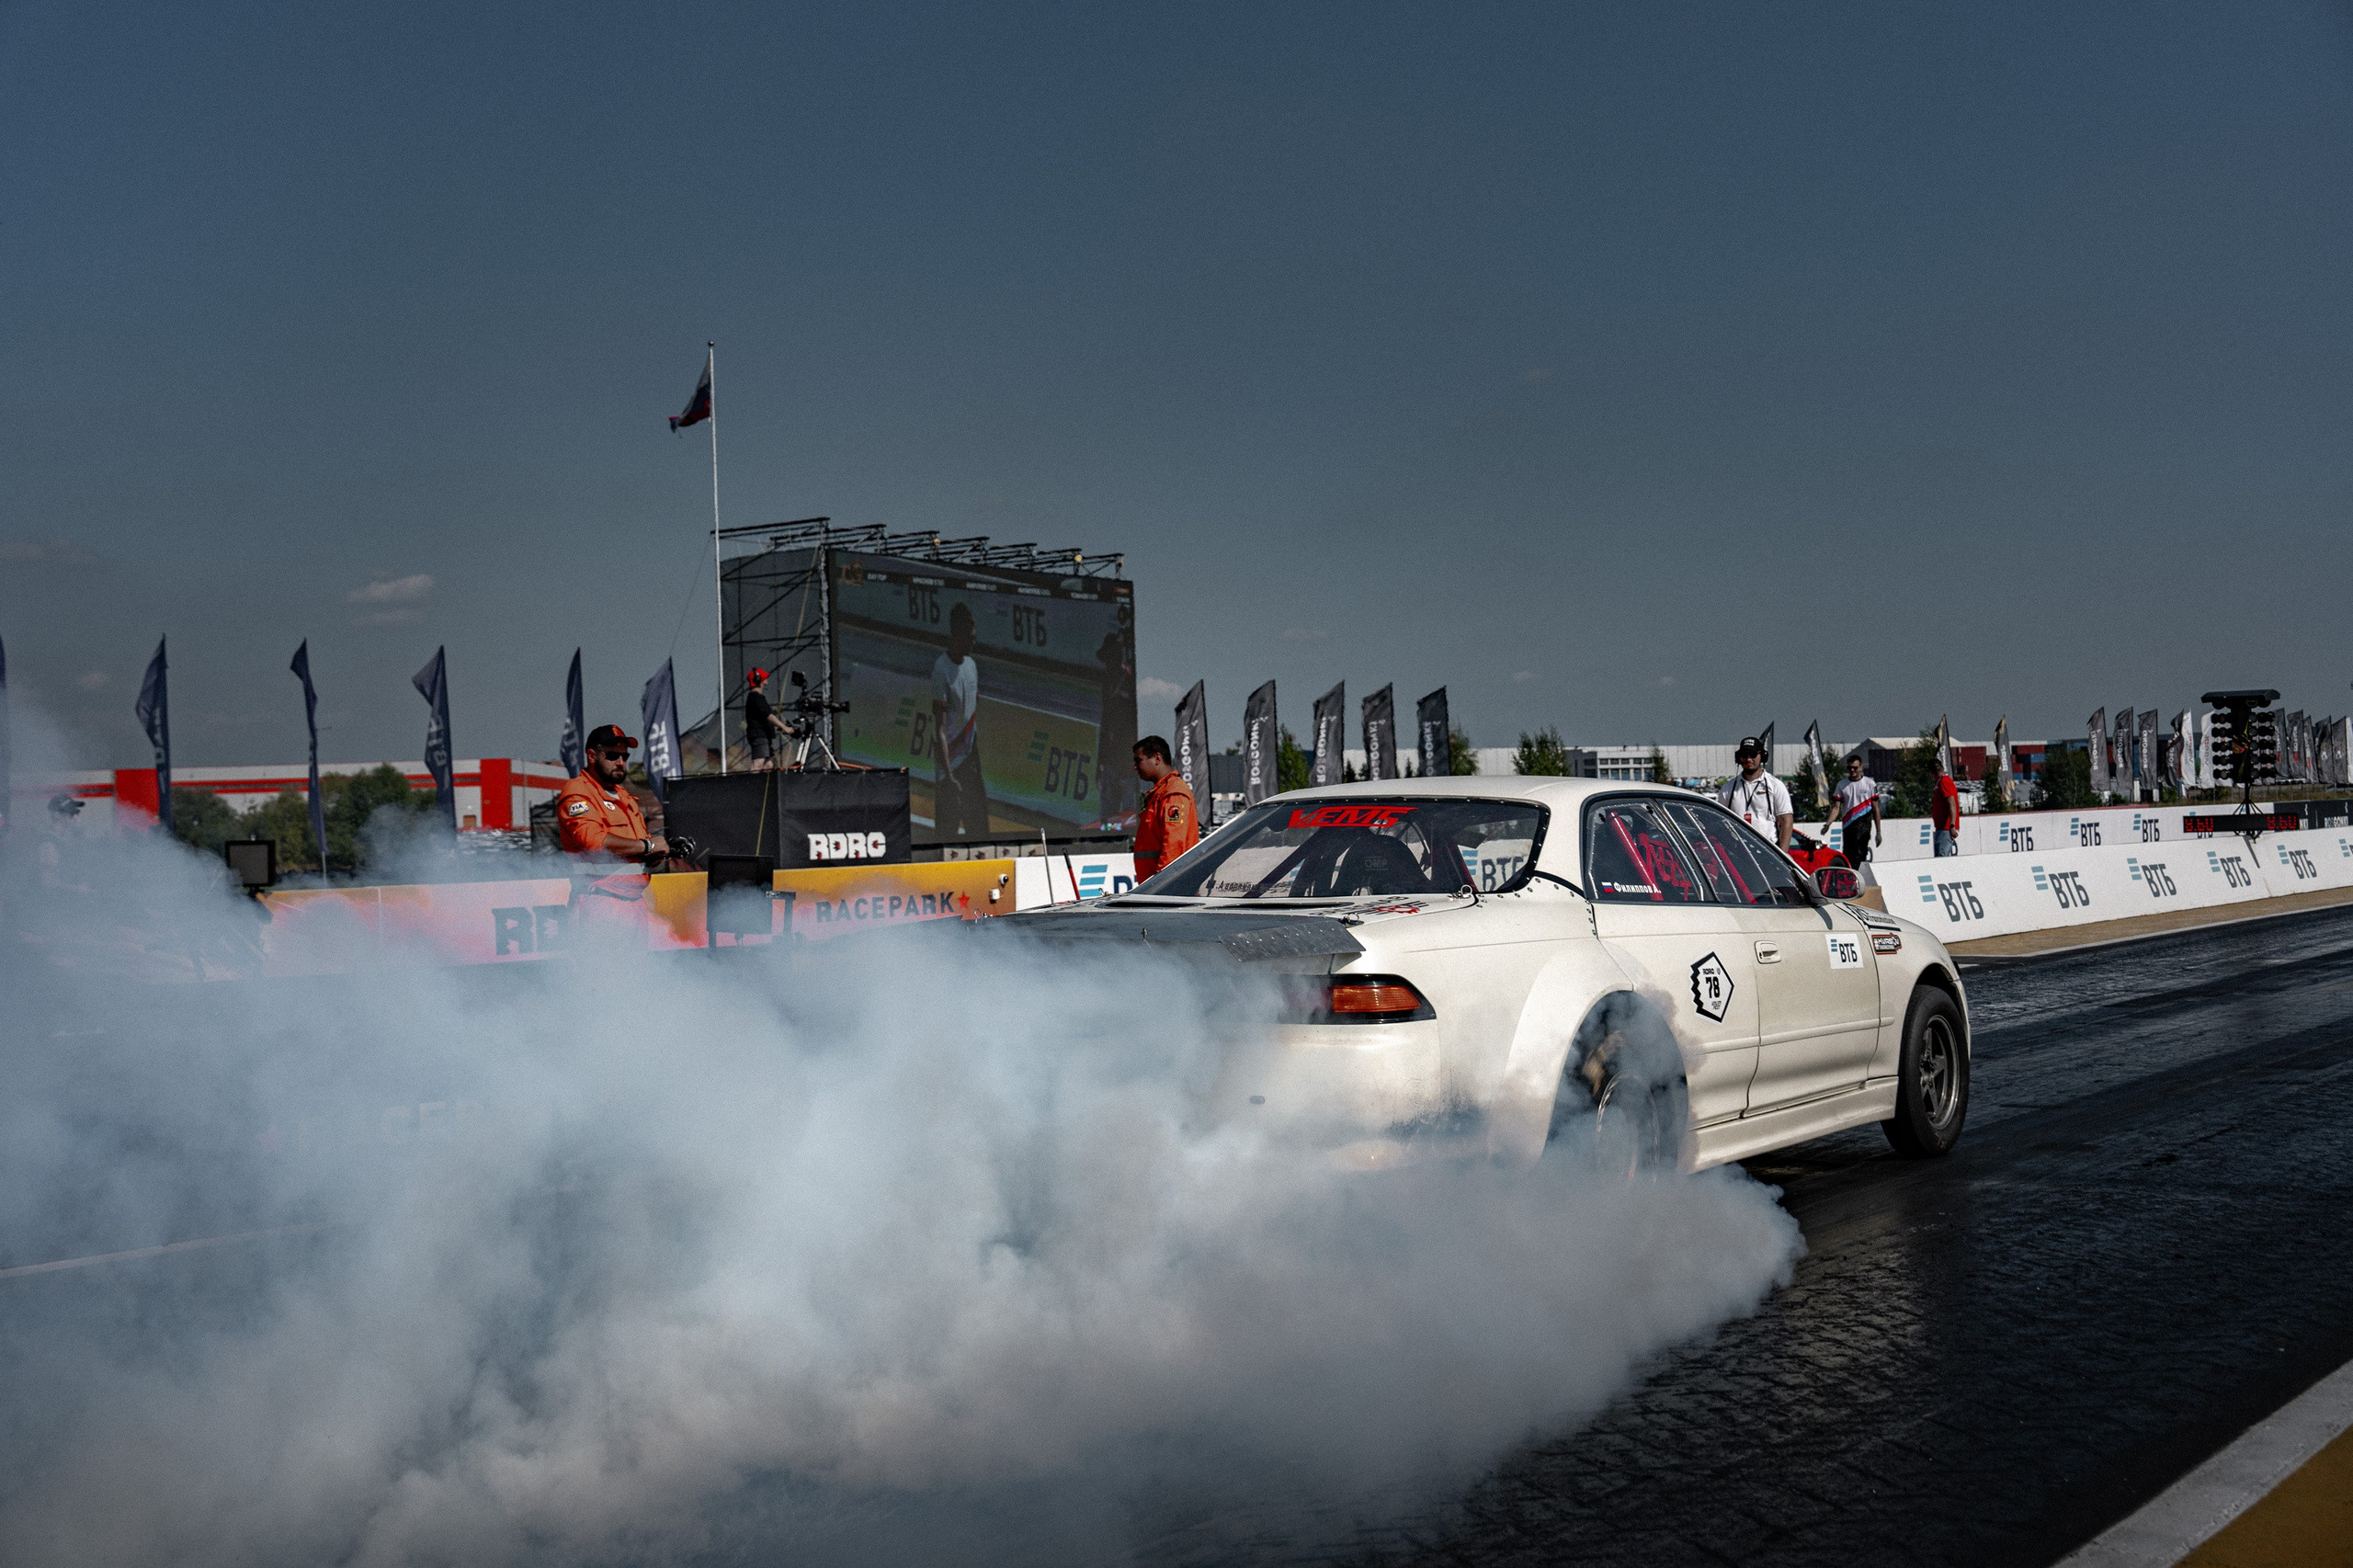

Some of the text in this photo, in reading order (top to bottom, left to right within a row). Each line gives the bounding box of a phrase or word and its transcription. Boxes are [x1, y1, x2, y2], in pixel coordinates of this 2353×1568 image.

[1013, 604, 1047, 647] ВТБ
[1044, 746, 1091, 801] ВТБ
[807, 831, 886, 860] RDRC
[2010, 826, 2034, 852] ВТБ
[2080, 822, 2101, 846] ВТБ
[2142, 818, 2160, 843] ВТБ
[2220, 856, 2252, 888] ВТБ
[2288, 849, 2317, 880] ВТБ
[1613, 881, 1653, 893] Филиппов
[2048, 871, 2090, 909] ВТБ
[2141, 863, 2177, 898] ВТБ
[815, 891, 955, 923] RACEPARK
[1937, 881, 1984, 923] ВТБ
[491, 904, 570, 956] RD
[1838, 943, 1858, 963] ВТБ
[1705, 976, 1721, 999] 78
